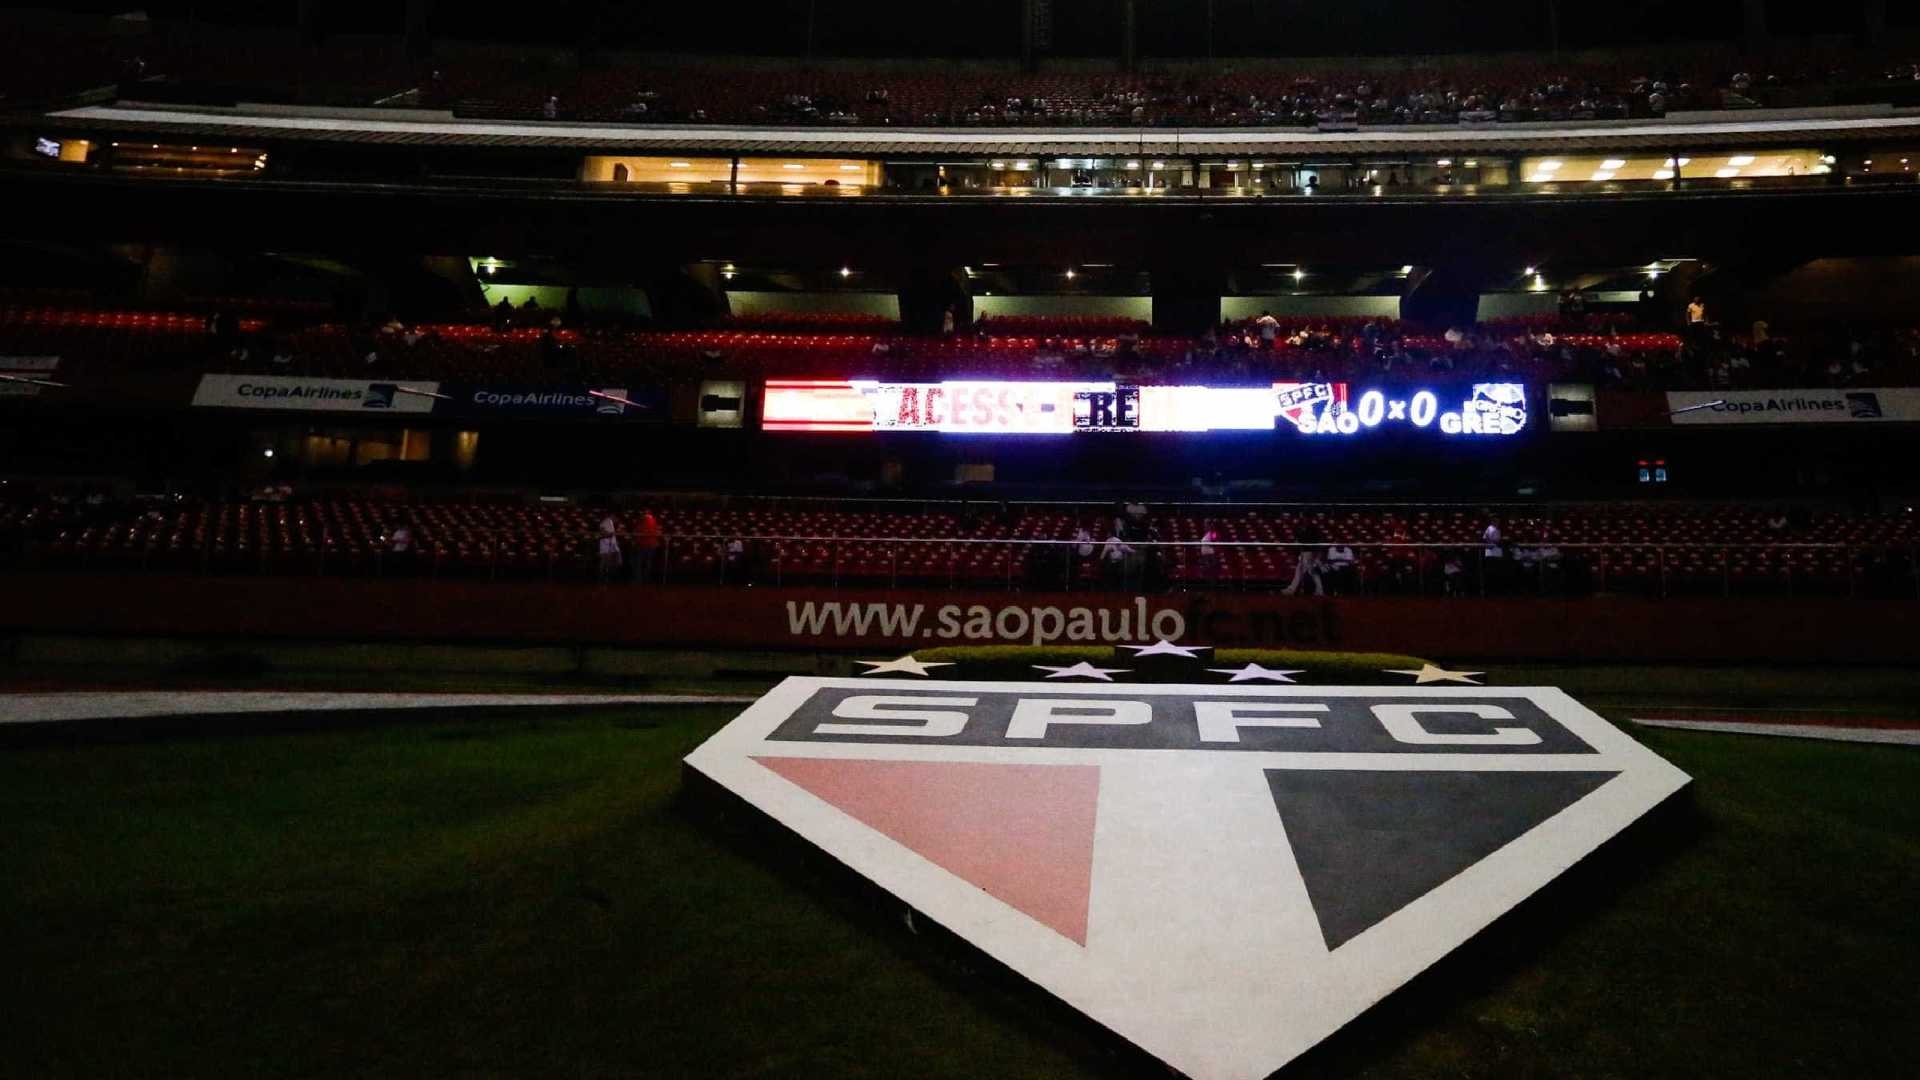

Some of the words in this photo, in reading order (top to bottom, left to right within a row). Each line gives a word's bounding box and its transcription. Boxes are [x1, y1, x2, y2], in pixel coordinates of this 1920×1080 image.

[237, 383, 363, 402] CopaAirlines
[472, 389, 596, 409] CopaAirlines
[1279, 383, 1328, 407] SPFC
[1358, 391, 1384, 426] 0
[1410, 391, 1437, 426] 0
[1711, 397, 1844, 413] CopaAirlines
[813, 695, 1543, 745] SPFC
